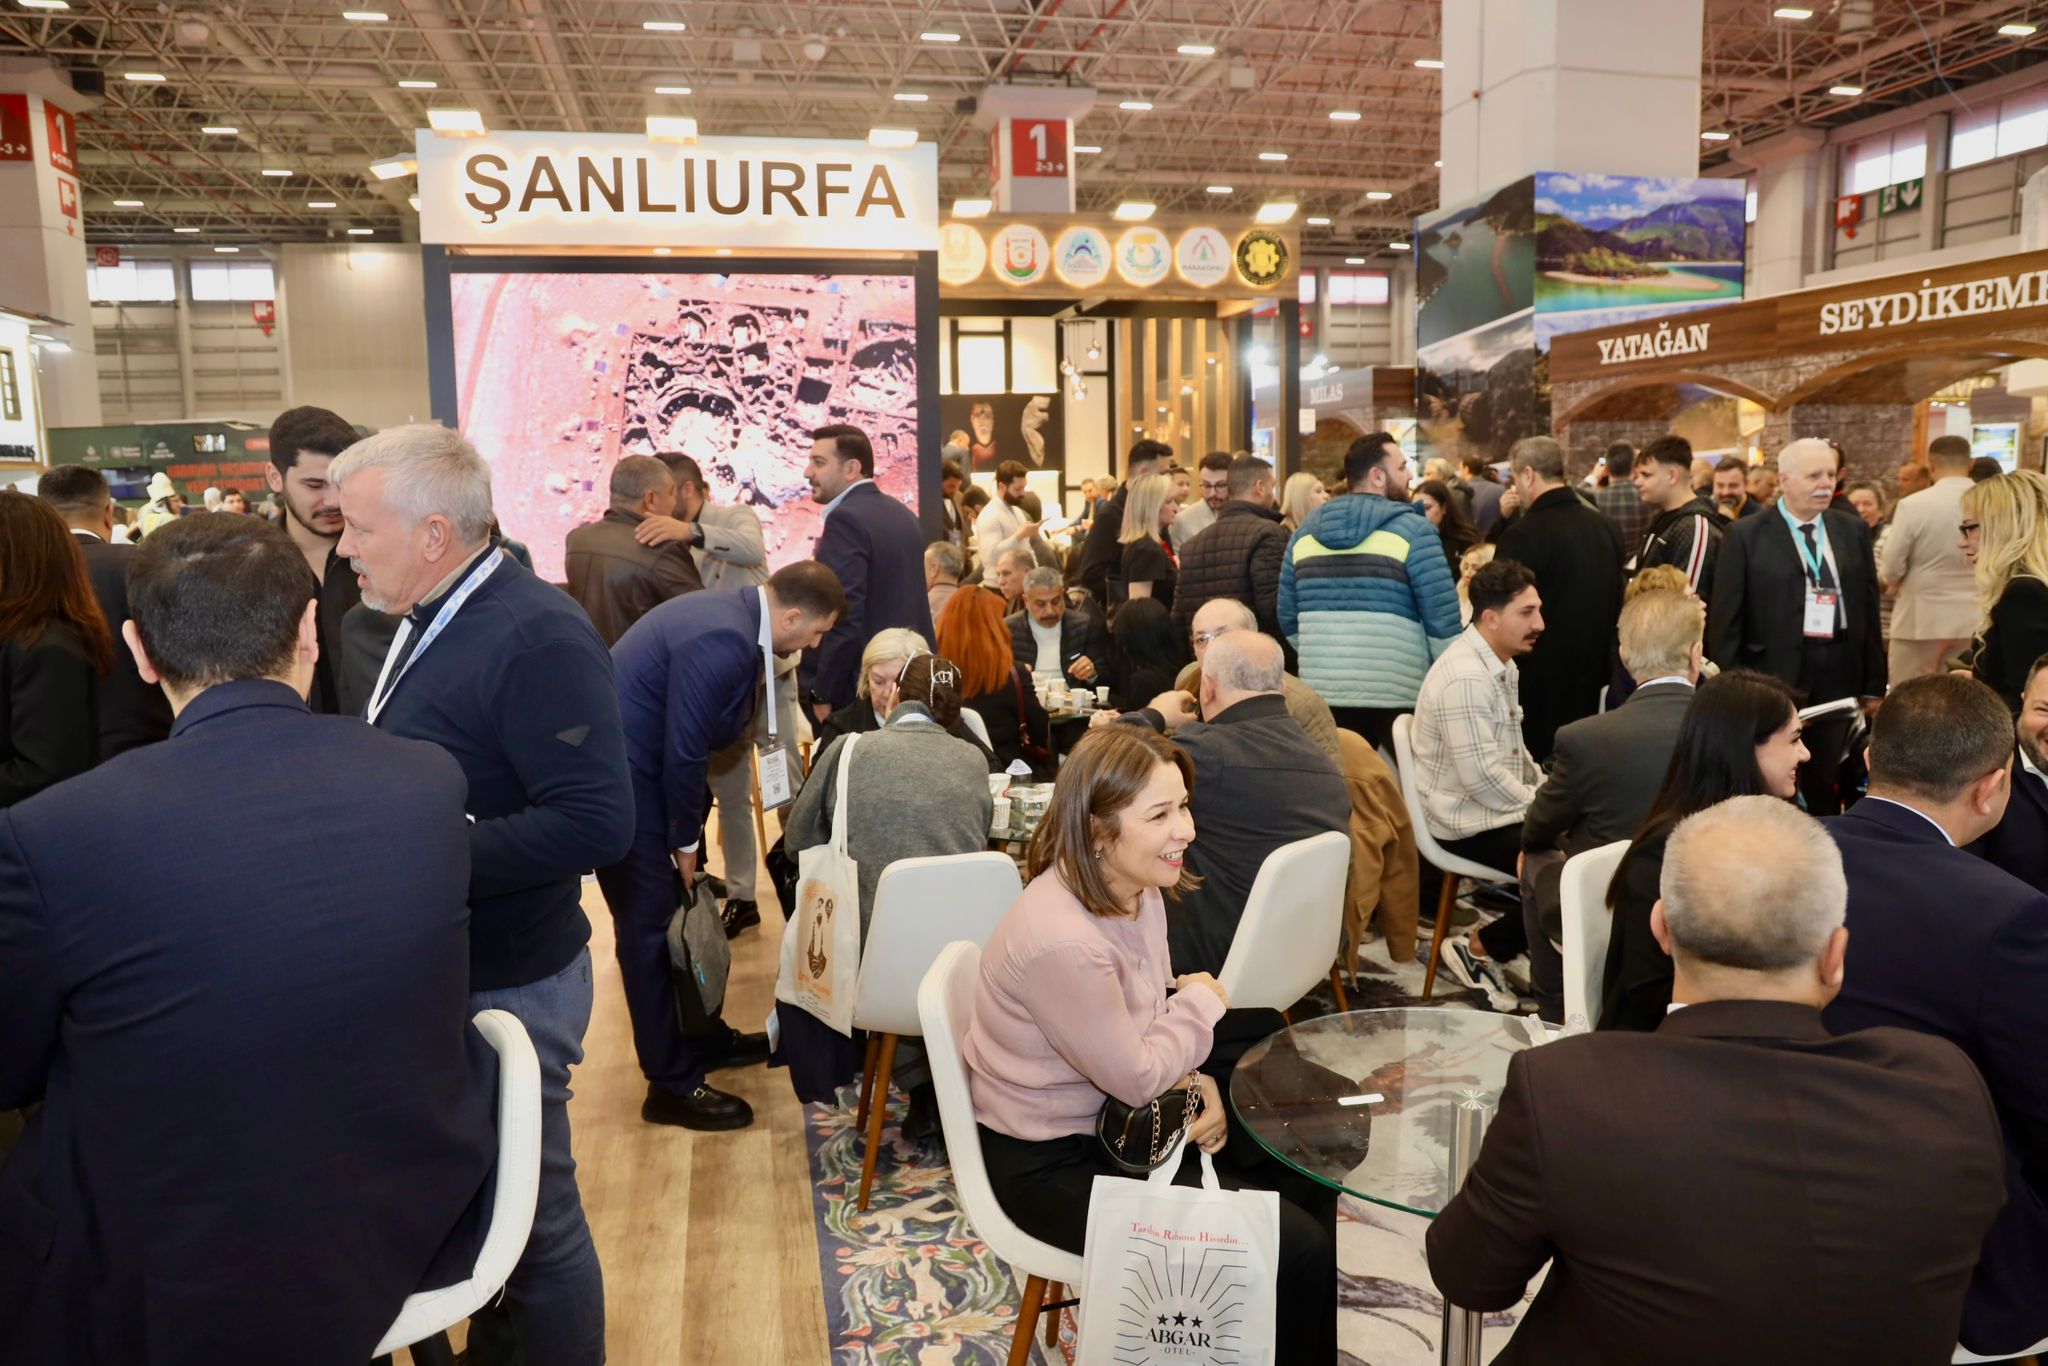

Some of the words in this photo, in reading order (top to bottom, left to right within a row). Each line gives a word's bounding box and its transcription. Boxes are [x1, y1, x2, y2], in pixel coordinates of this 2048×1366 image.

[55, 113, 68, 154] 1
[1029, 123, 1047, 161] 1
[1036, 161, 1054, 173] 2-3
[464, 153, 907, 224] ŞANLIURFA
[1597, 321, 1711, 365] YATAĞAN
[1145, 1327, 1211, 1348] ABGAR
